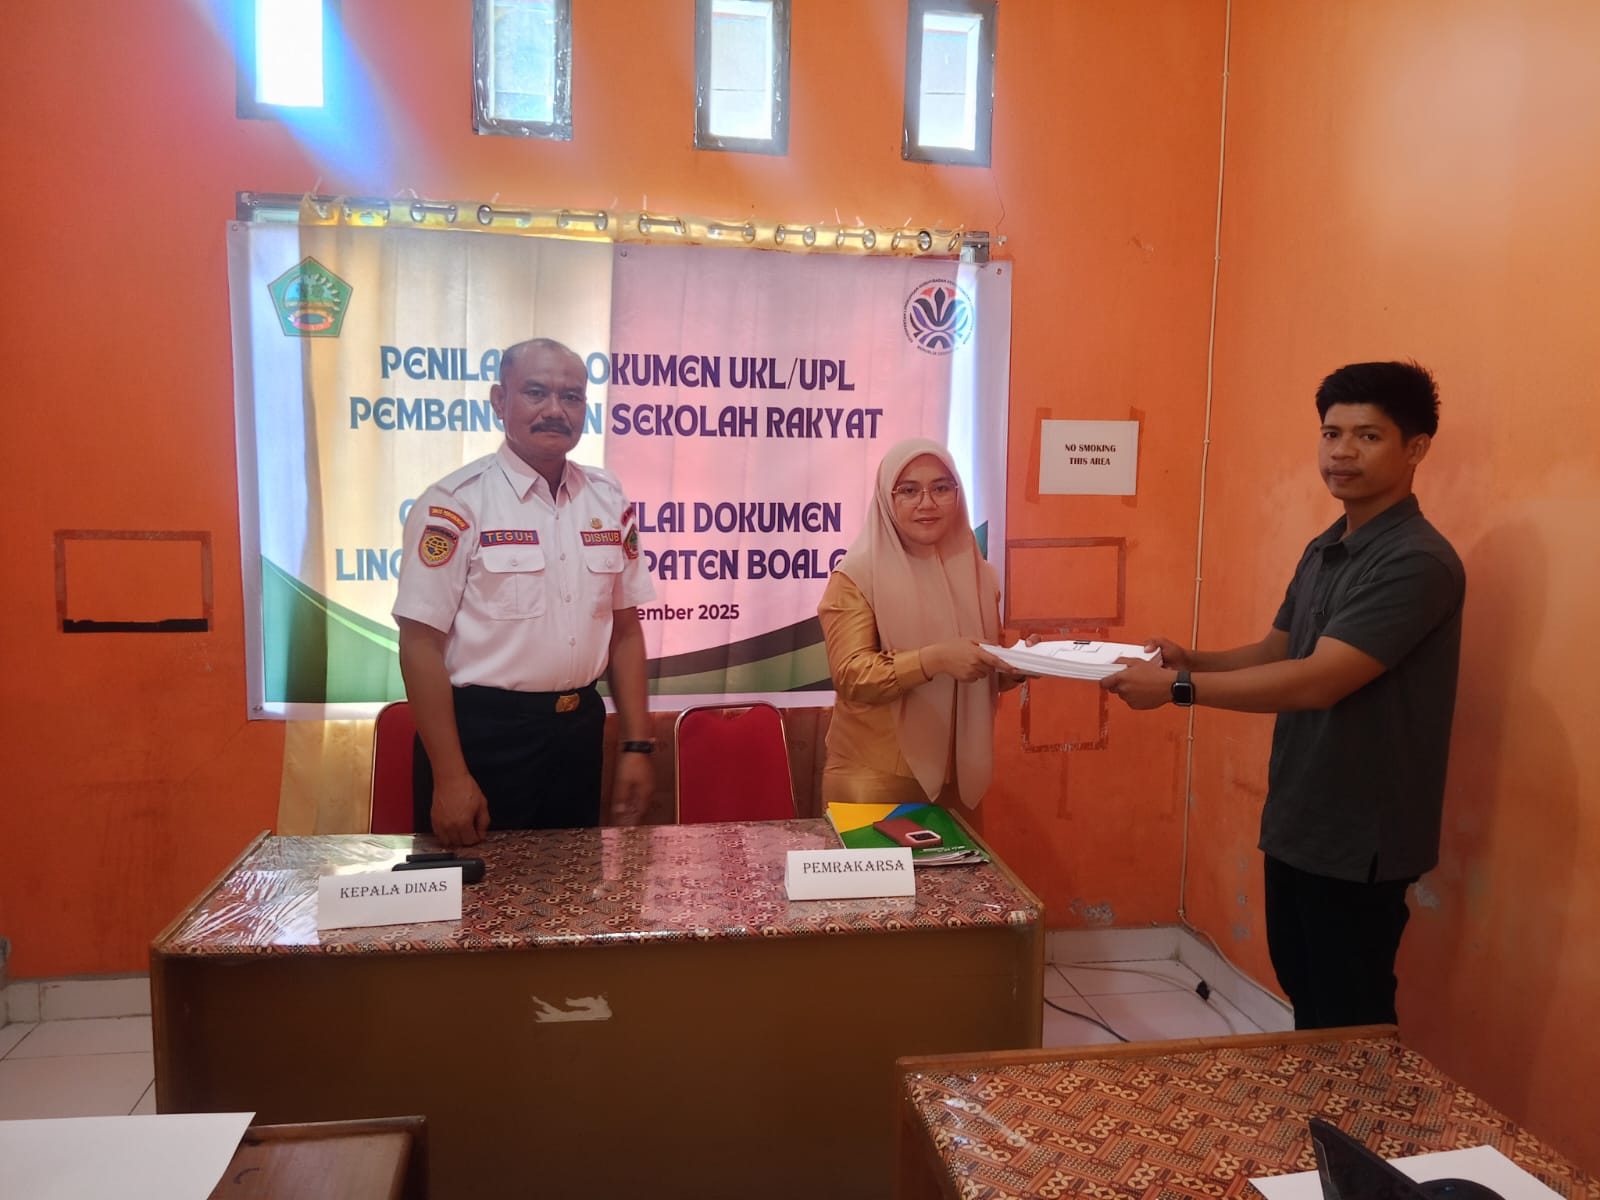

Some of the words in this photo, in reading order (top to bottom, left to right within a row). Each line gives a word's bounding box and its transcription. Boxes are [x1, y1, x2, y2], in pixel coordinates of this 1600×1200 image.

[380, 345, 504, 382] PENILA
[586, 351, 721, 388] OKUMEN
[729, 355, 855, 391] UKL/UPL
[611, 402, 758, 437] SEKOLAH
[766, 406, 884, 439] RAKYAT
[1065, 443, 1077, 452] NO
[1078, 443, 1117, 453] SMOKING
[1069, 457, 1088, 465] THIS
[1090, 457, 1111, 466] AREA
[631, 501, 685, 532] LAI
[693, 501, 842, 533] DOKUMEN
[485, 531, 534, 543] TEGUH
[583, 532, 619, 543] DISHUB
[336, 548, 403, 581] LIN
[636, 604, 694, 620] ember
[698, 604, 740, 620] 2025
[803, 859, 905, 874] PEMRAKARSA
[340, 884, 400, 899] KEPALA
[405, 880, 448, 894] DINAS
